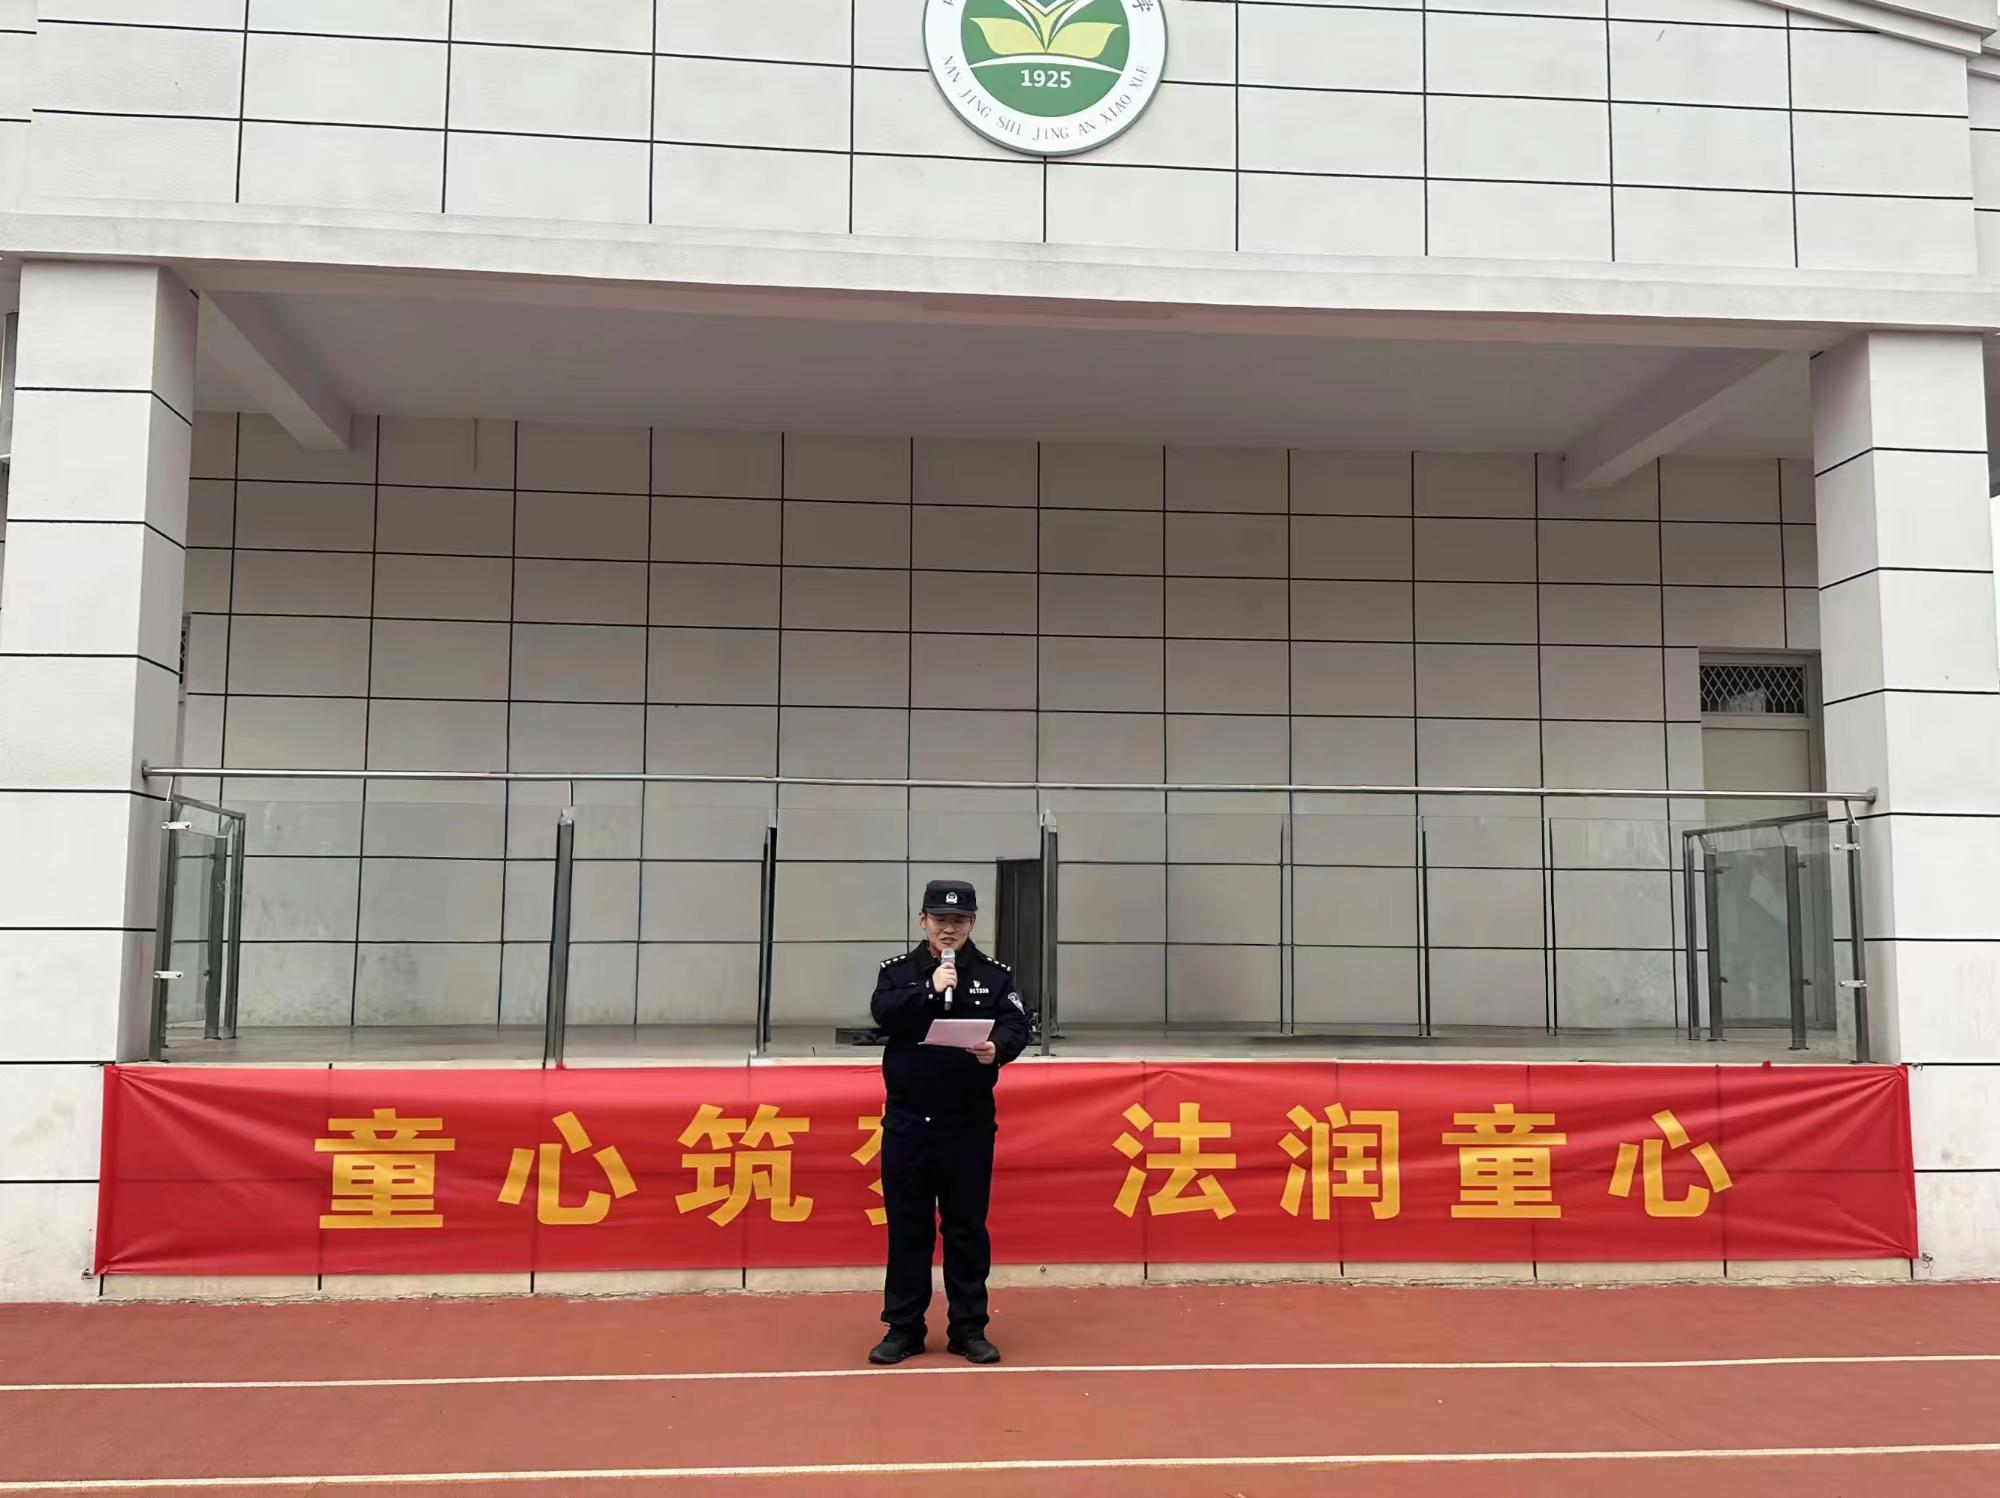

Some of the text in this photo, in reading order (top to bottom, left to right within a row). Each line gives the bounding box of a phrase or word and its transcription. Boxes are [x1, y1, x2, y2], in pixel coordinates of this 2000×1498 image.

[943, 55, 961, 83] NAN
[960, 89, 992, 118] JING
[996, 115, 1022, 135] SHI
[1032, 126, 1069, 140] JING
[1078, 120, 1097, 136] AN
[1099, 94, 1132, 124] XIAO
[1020, 69, 1072, 88] 1925
[315, 1102, 1733, 1228] 童心筑 法润童心
